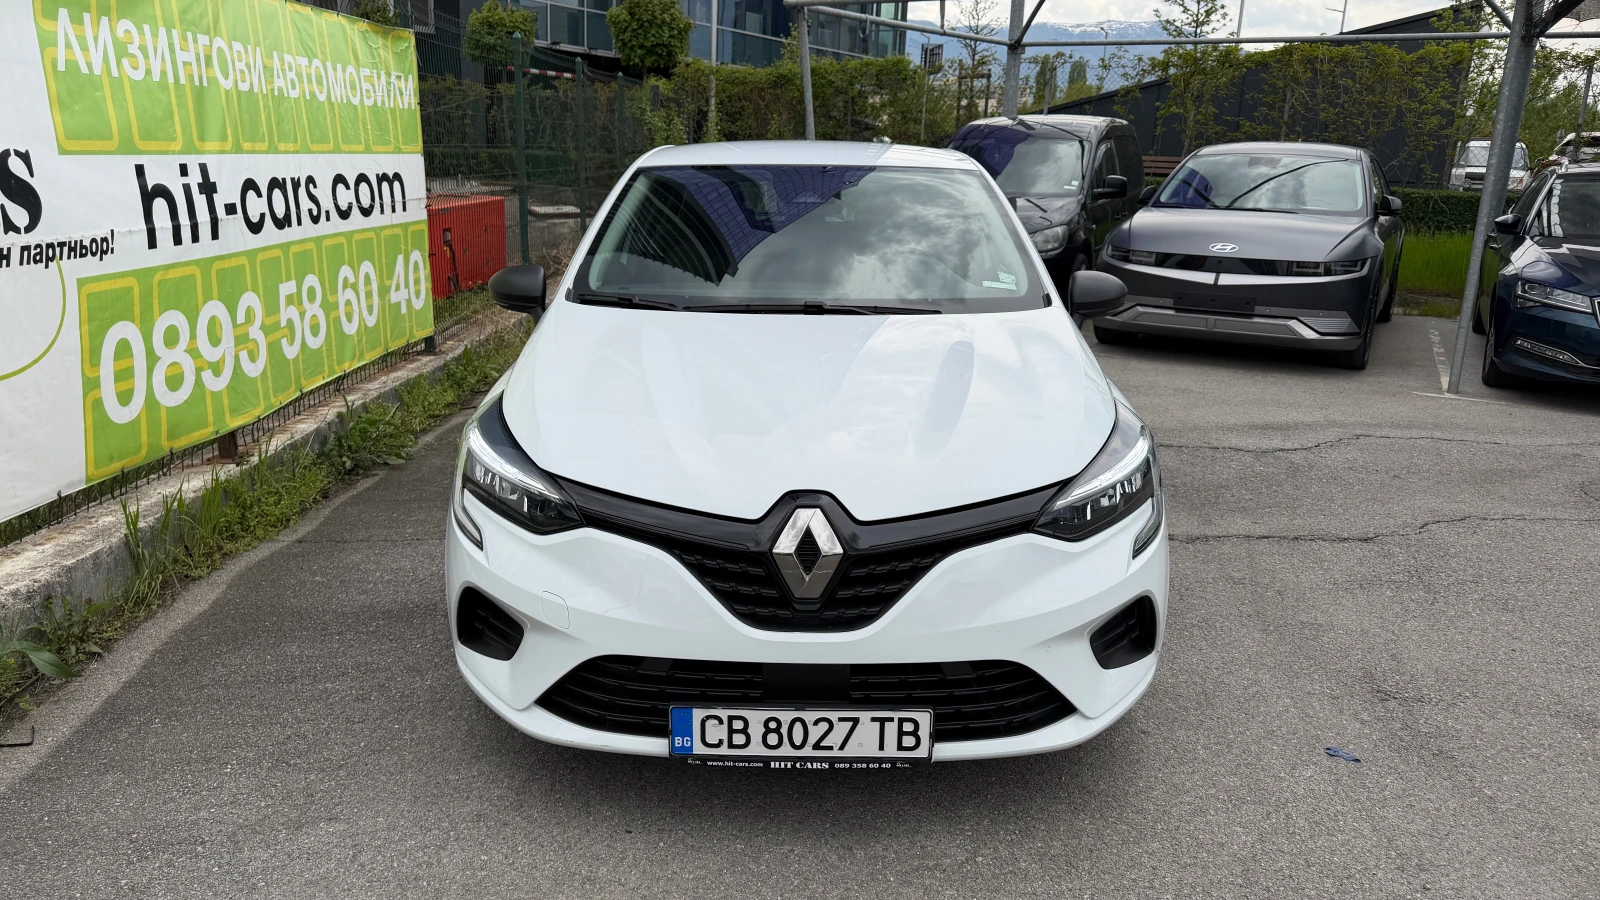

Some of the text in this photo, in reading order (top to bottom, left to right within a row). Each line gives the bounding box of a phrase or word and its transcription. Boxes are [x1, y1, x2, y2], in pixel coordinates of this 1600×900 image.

[56, 7, 416, 111] ЛИЗИНГОВИ АВТОМОБИЛИ
[134, 162, 408, 250] hit-cars.com
[18, 228, 115, 270] партньор!
[100, 249, 426, 425] 0893 58 60 40
[674, 736, 692, 748] BG
[700, 714, 922, 752] CB 8027 TB
[706, 760, 764, 768] www.hit-cars.com
[769, 761, 830, 769] HIT CARS
